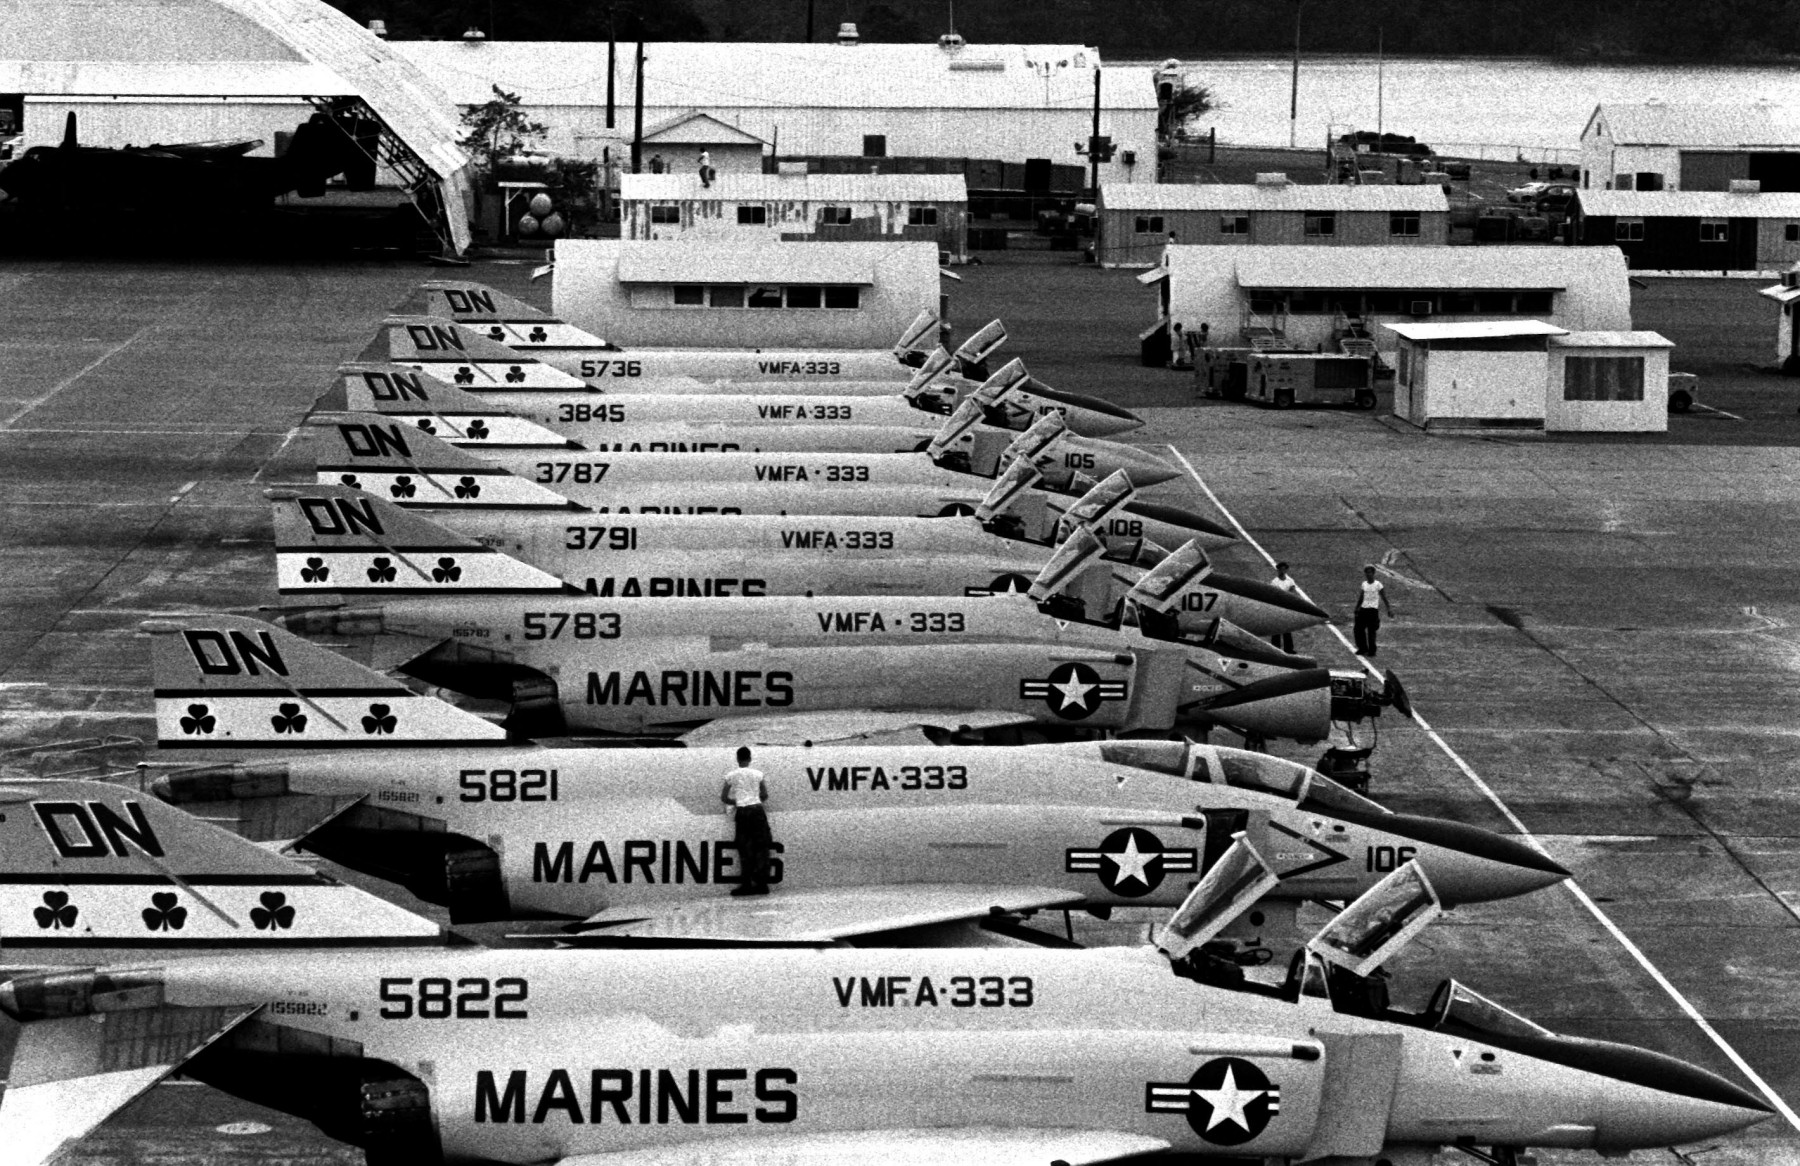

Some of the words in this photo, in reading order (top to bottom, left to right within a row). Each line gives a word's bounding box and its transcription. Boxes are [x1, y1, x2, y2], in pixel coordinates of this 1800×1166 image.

[444, 289, 497, 314] DN
[406, 325, 466, 351] DN
[580, 360, 642, 378] 5736
[362, 372, 430, 401] DN
[559, 404, 626, 423] 3845
[338, 424, 412, 457] DN
[536, 463, 611, 484] 3787
[1064, 453, 1095, 469] 105
[298, 498, 386, 536] DN
[1108, 518, 1143, 537] 108
[565, 526, 638, 551] 3791
[1180, 592, 1218, 612] 107
[523, 612, 622, 640] 5783
[184, 629, 290, 676] DN
[586, 671, 795, 707] MARINES
[459, 769, 559, 803] 5821
[32, 801, 166, 858] DN
[533, 840, 785, 884] MARINES
[1366, 846, 1417, 873] 106
[271, 1001, 328, 1015] 155822
[380, 977, 529, 1020] 5822
[474, 1068, 799, 1125] MARINES
